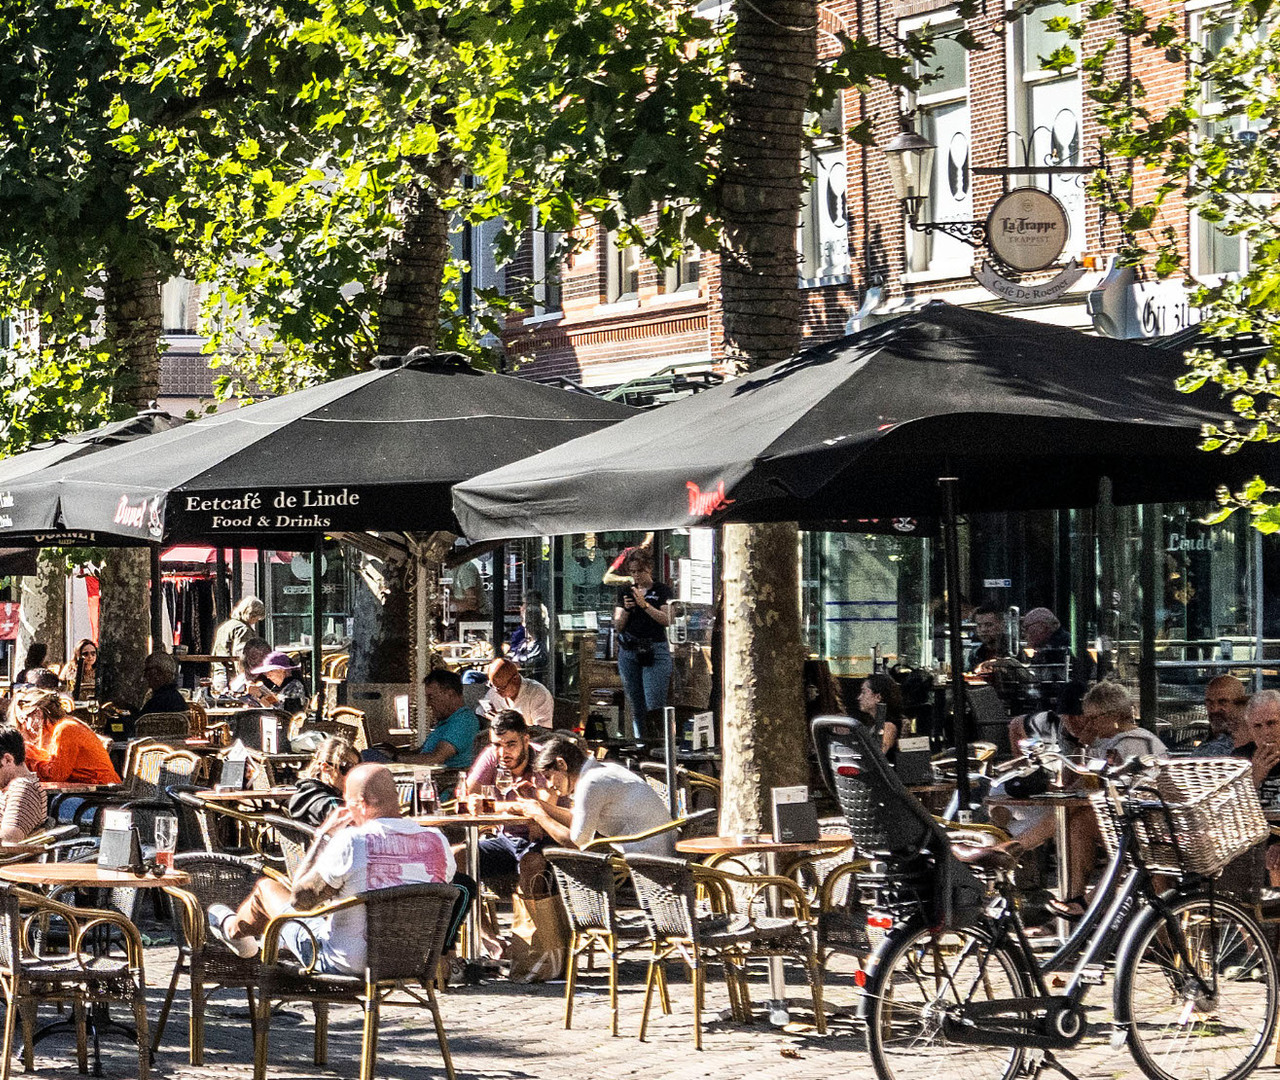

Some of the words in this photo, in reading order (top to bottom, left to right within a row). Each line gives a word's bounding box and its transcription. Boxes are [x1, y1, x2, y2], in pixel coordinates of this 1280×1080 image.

[1016, 216, 1057, 234] Trappe
[992, 280, 1015, 297] Café
[1016, 290, 1031, 300] De
[1032, 279, 1069, 299] Roemer
[185, 493, 262, 511] Eetcafé
[273, 491, 297, 509] de
[302, 489, 360, 507] Linde
[114, 494, 147, 528] Duvel
[211, 516, 252, 528] Food
[257, 516, 270, 527] &
[274, 514, 331, 527] Drinks
